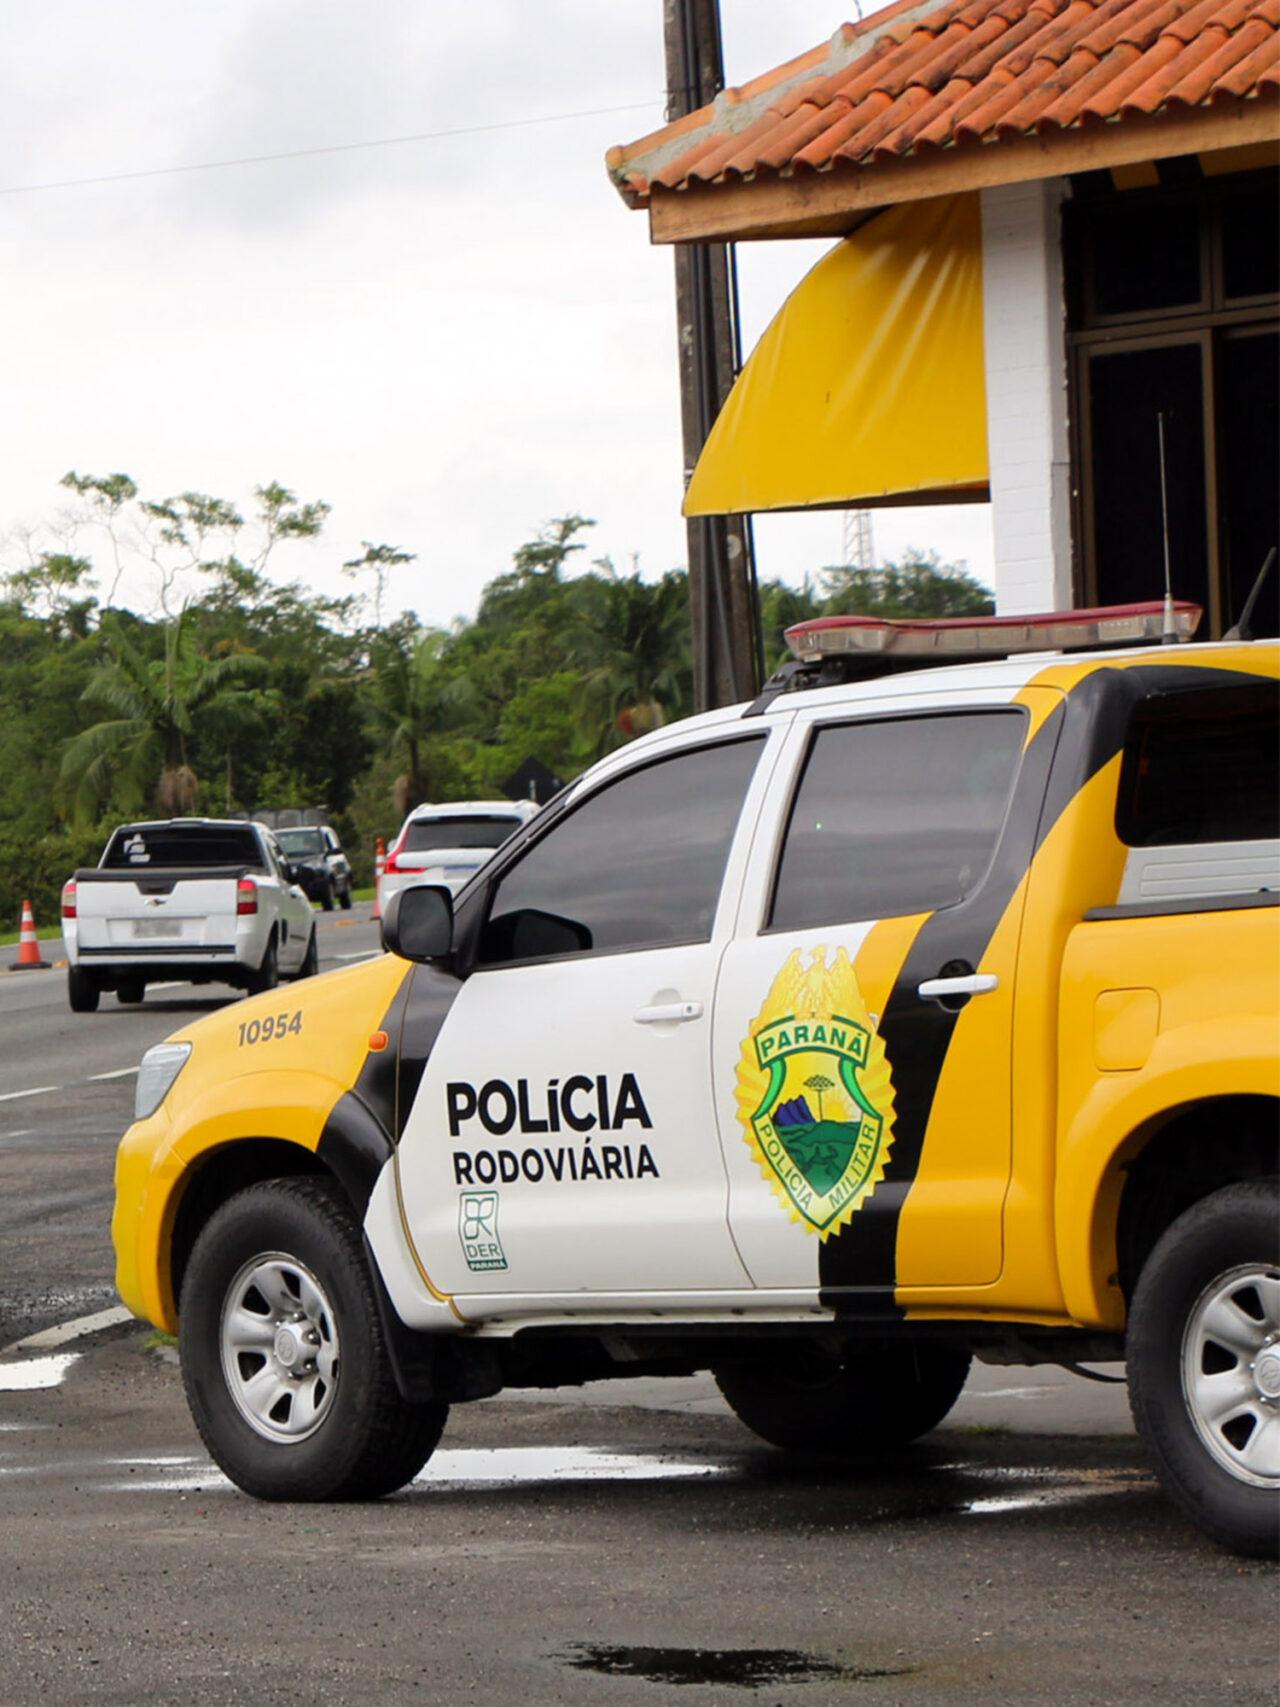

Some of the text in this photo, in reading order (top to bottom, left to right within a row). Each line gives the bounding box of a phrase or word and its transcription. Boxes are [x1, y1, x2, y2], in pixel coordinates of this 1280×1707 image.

[238, 1010, 302, 1047] 10954
[760, 1025, 863, 1057] PARANÁ
[452, 1136, 659, 1184] RODOVIÁRIA
[827, 1124, 876, 1209] MILITAR
[466, 1243, 500, 1259] DER
